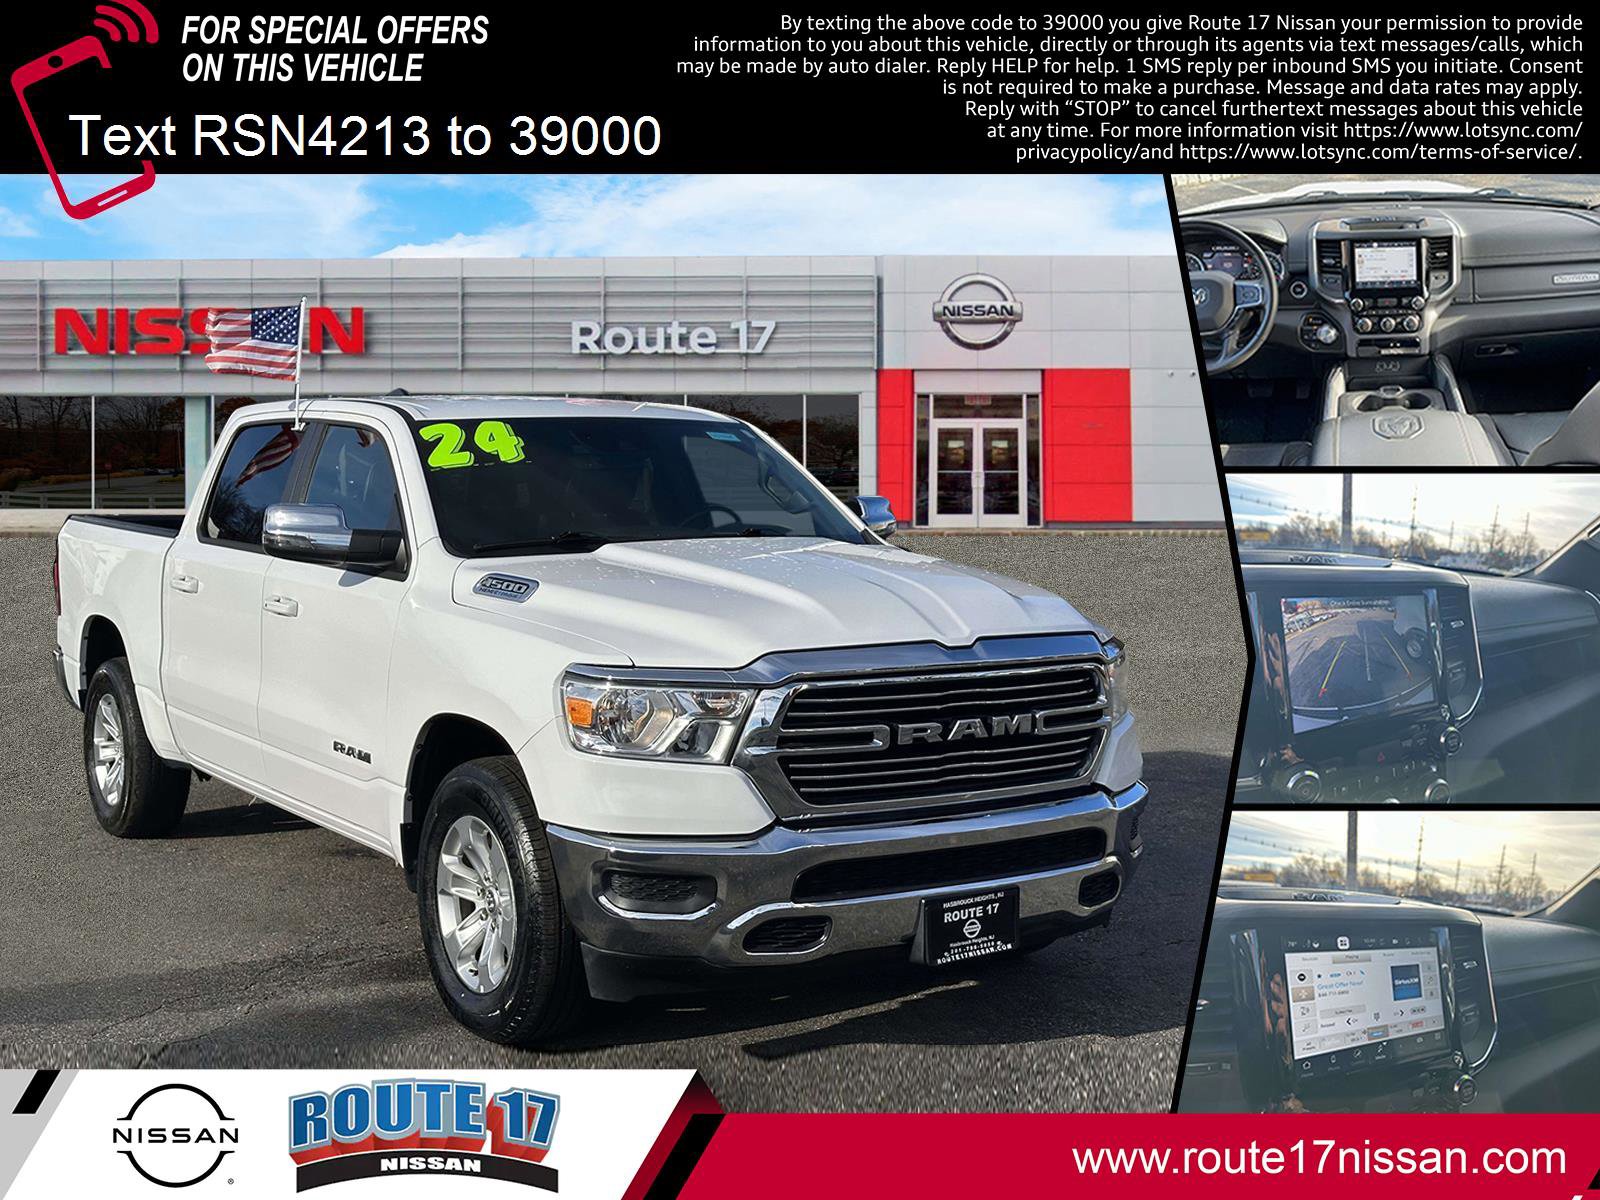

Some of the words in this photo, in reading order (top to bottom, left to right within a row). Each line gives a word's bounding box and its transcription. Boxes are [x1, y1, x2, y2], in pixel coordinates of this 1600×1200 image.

[942, 304, 1014, 317] NISSAN
[54, 307, 365, 355] NISN
[570, 319, 718, 356] Route
[731, 319, 777, 355] 17
[419, 421, 525, 469] 24
[480, 577, 529, 593] 1500
[897, 713, 1033, 745] RAM
[333, 741, 372, 765] RAM
[944, 906, 984, 923] ROUTE
[986, 903, 1000, 915] 17
